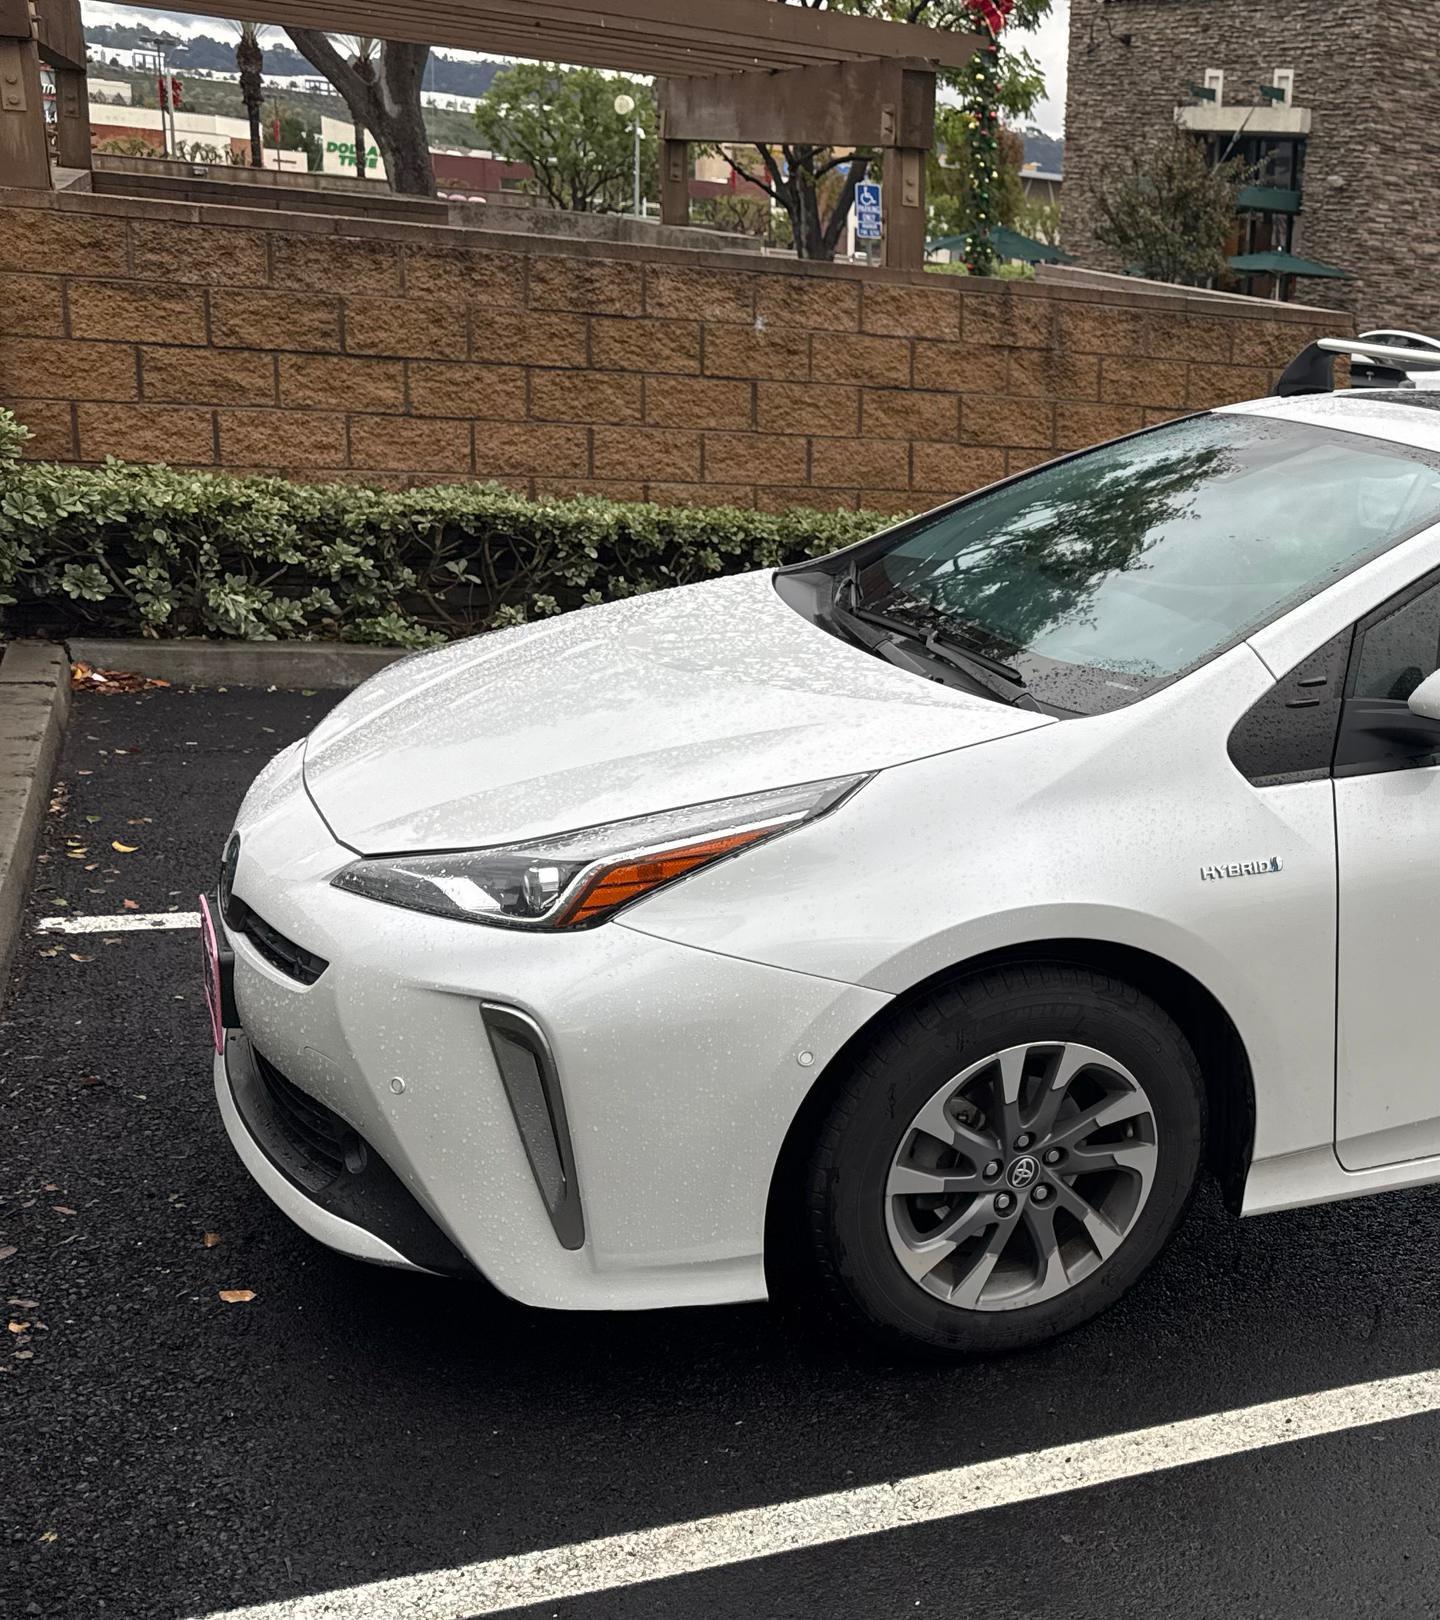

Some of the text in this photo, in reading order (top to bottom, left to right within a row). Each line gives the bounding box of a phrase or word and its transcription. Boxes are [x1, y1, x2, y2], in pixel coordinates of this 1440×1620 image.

[326, 141, 378, 158] DOLA
[339, 155, 378, 169] TRE
[1200, 860, 1270, 881] HYBRID
